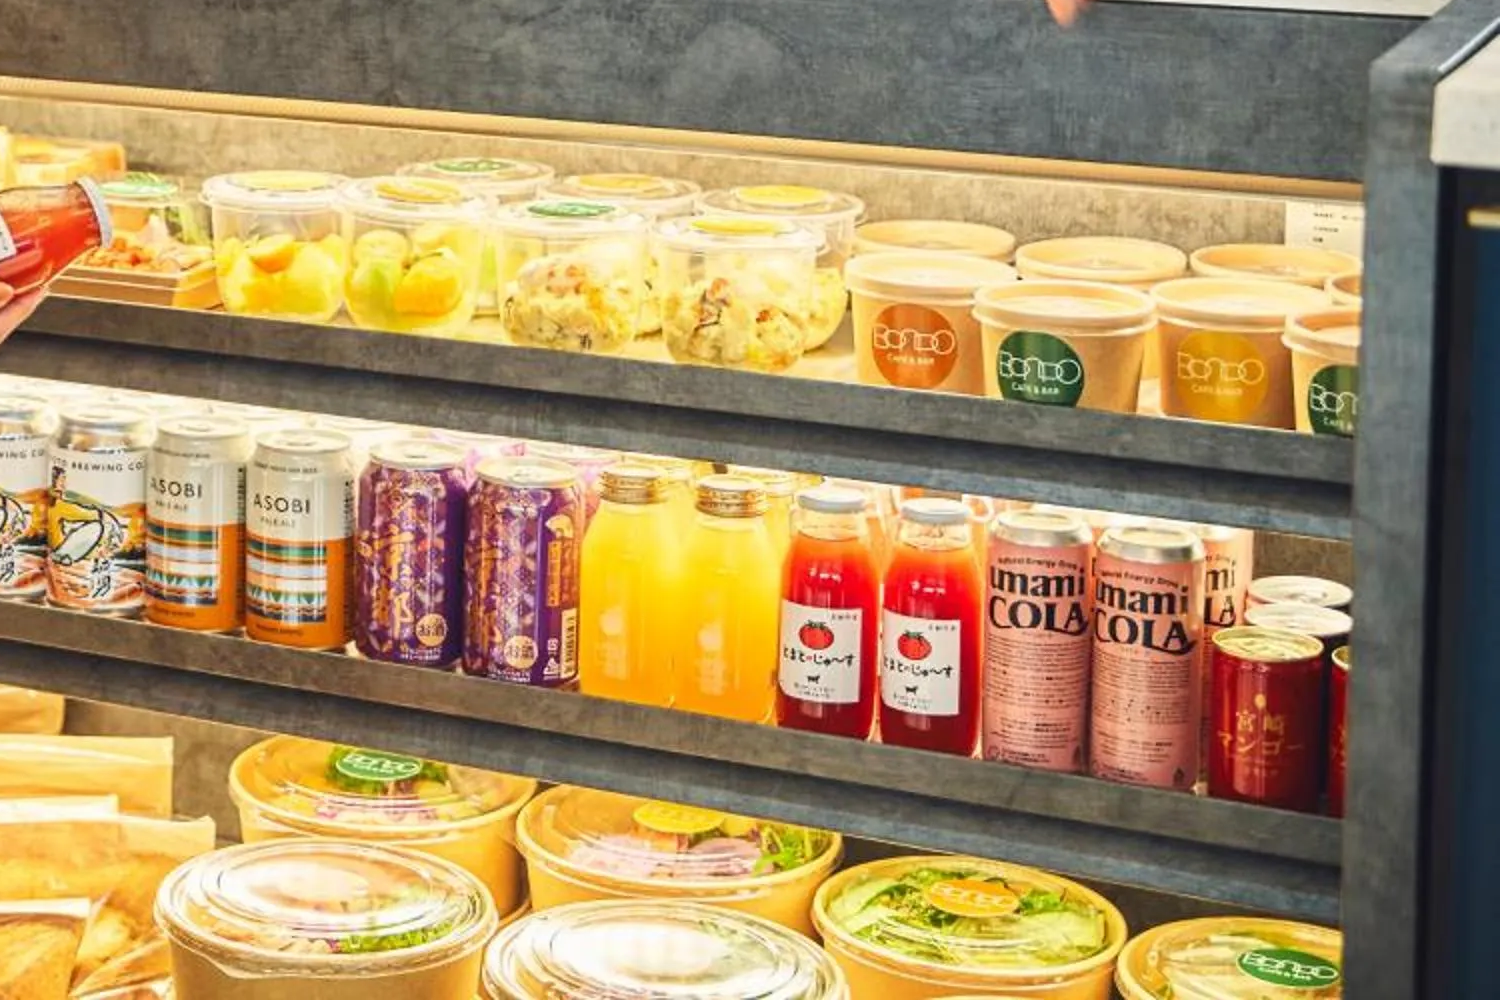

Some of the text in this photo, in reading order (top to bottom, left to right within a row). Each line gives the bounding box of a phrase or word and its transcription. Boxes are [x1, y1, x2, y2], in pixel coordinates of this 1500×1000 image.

[151, 477, 203, 499] ASOBI
[253, 493, 311, 515] ASOBI
[989, 565, 1085, 598] umami
[989, 595, 1089, 636] COLA
[1203, 595, 1237, 627] LA
[1095, 608, 1199, 656] COLA
